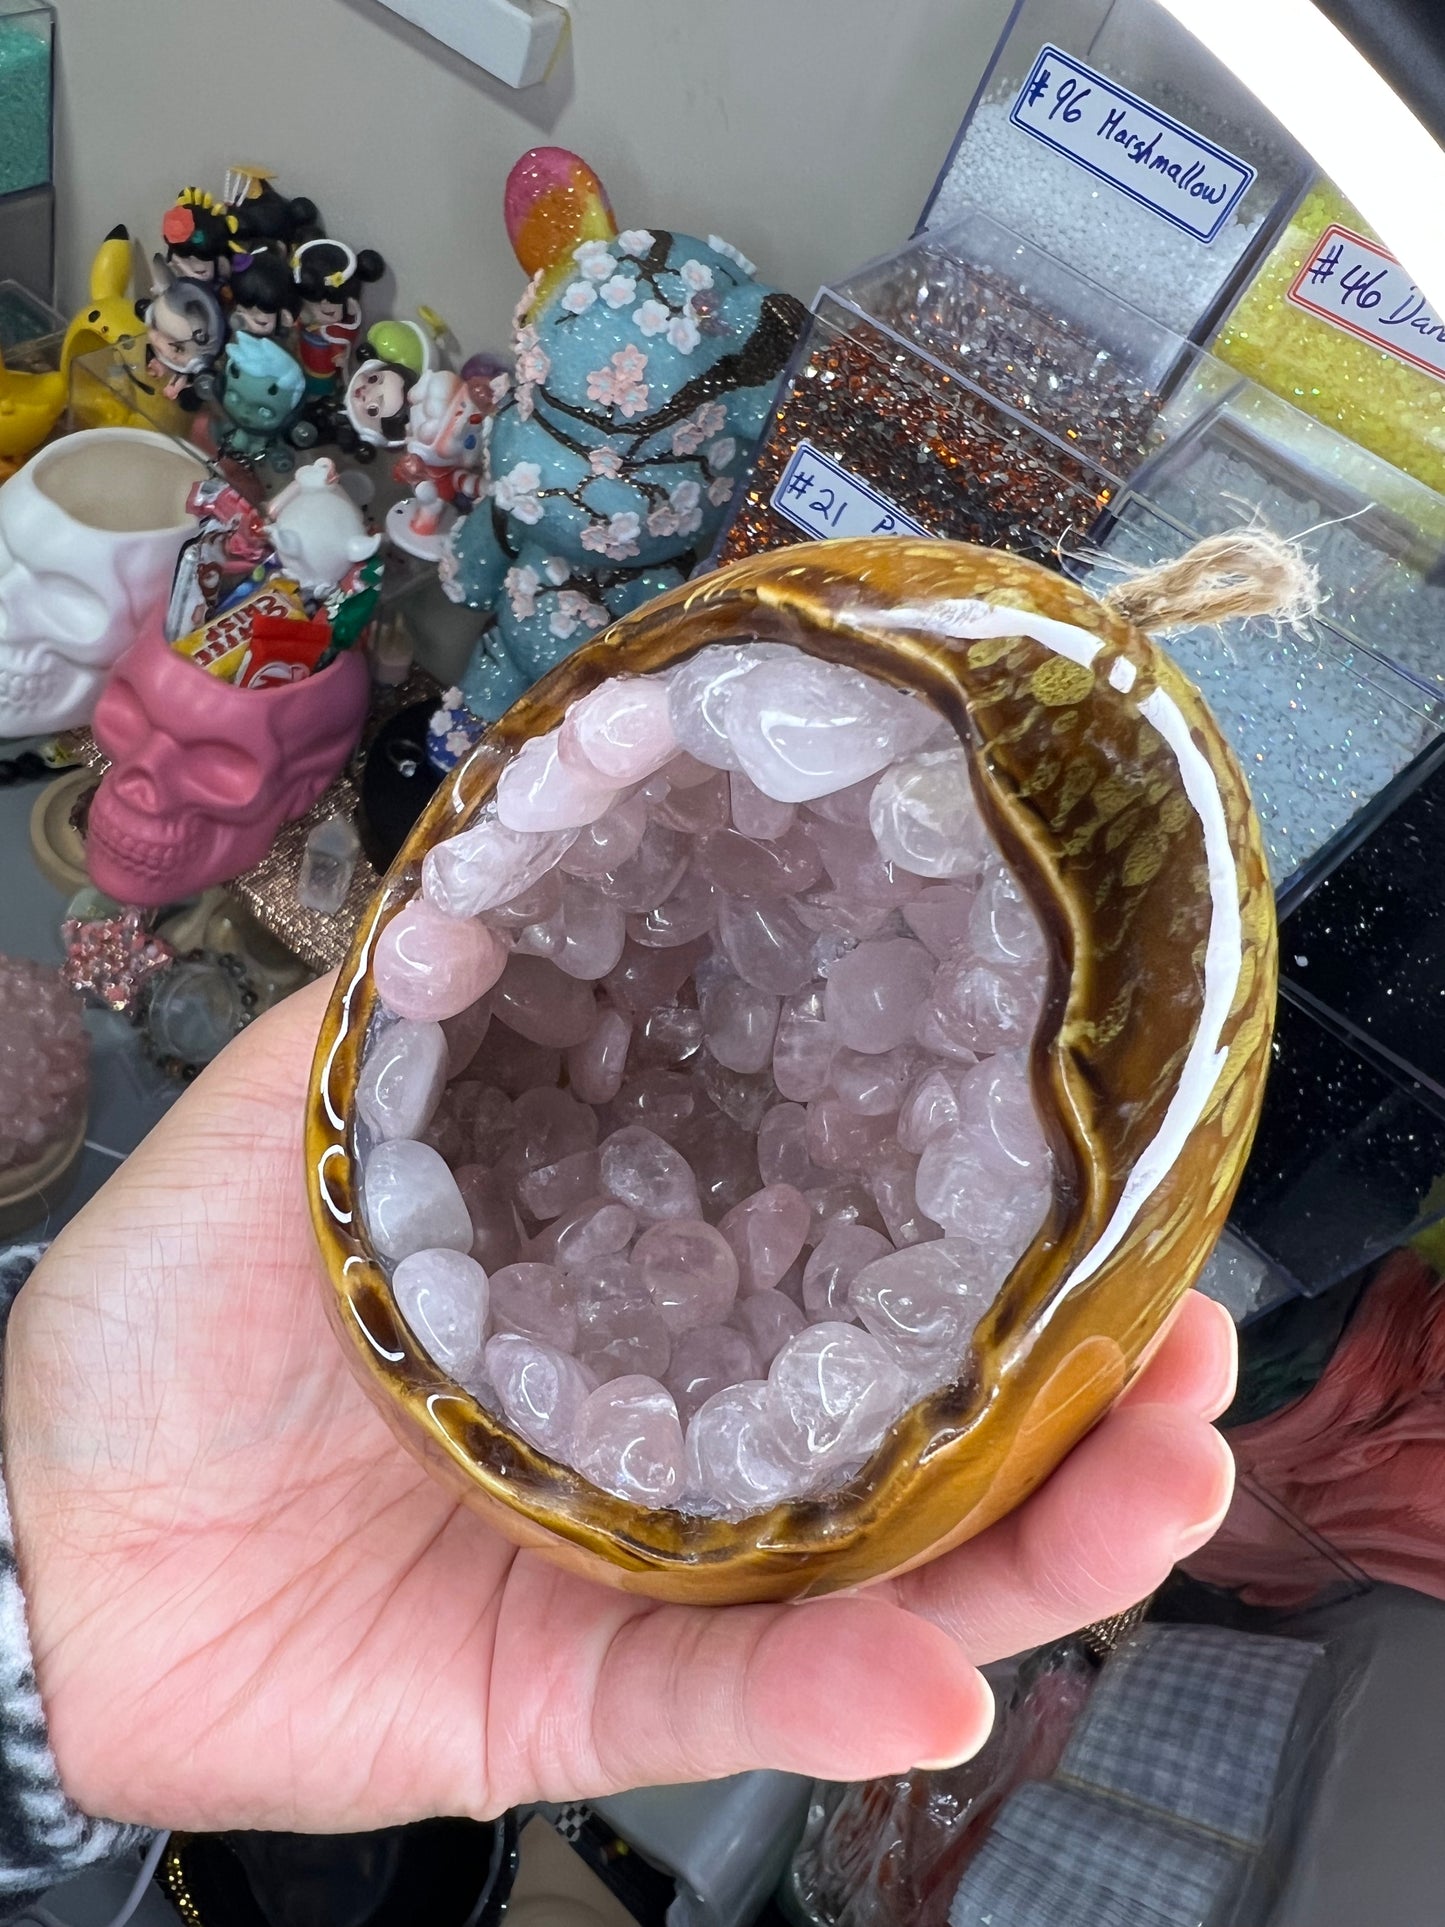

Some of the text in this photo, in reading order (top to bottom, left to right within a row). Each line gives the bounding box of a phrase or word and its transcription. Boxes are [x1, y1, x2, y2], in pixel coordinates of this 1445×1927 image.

[1097, 108, 1227, 205] Marshmallow
[1309, 244, 1382, 309] #46
[787, 472, 848, 527] #21
